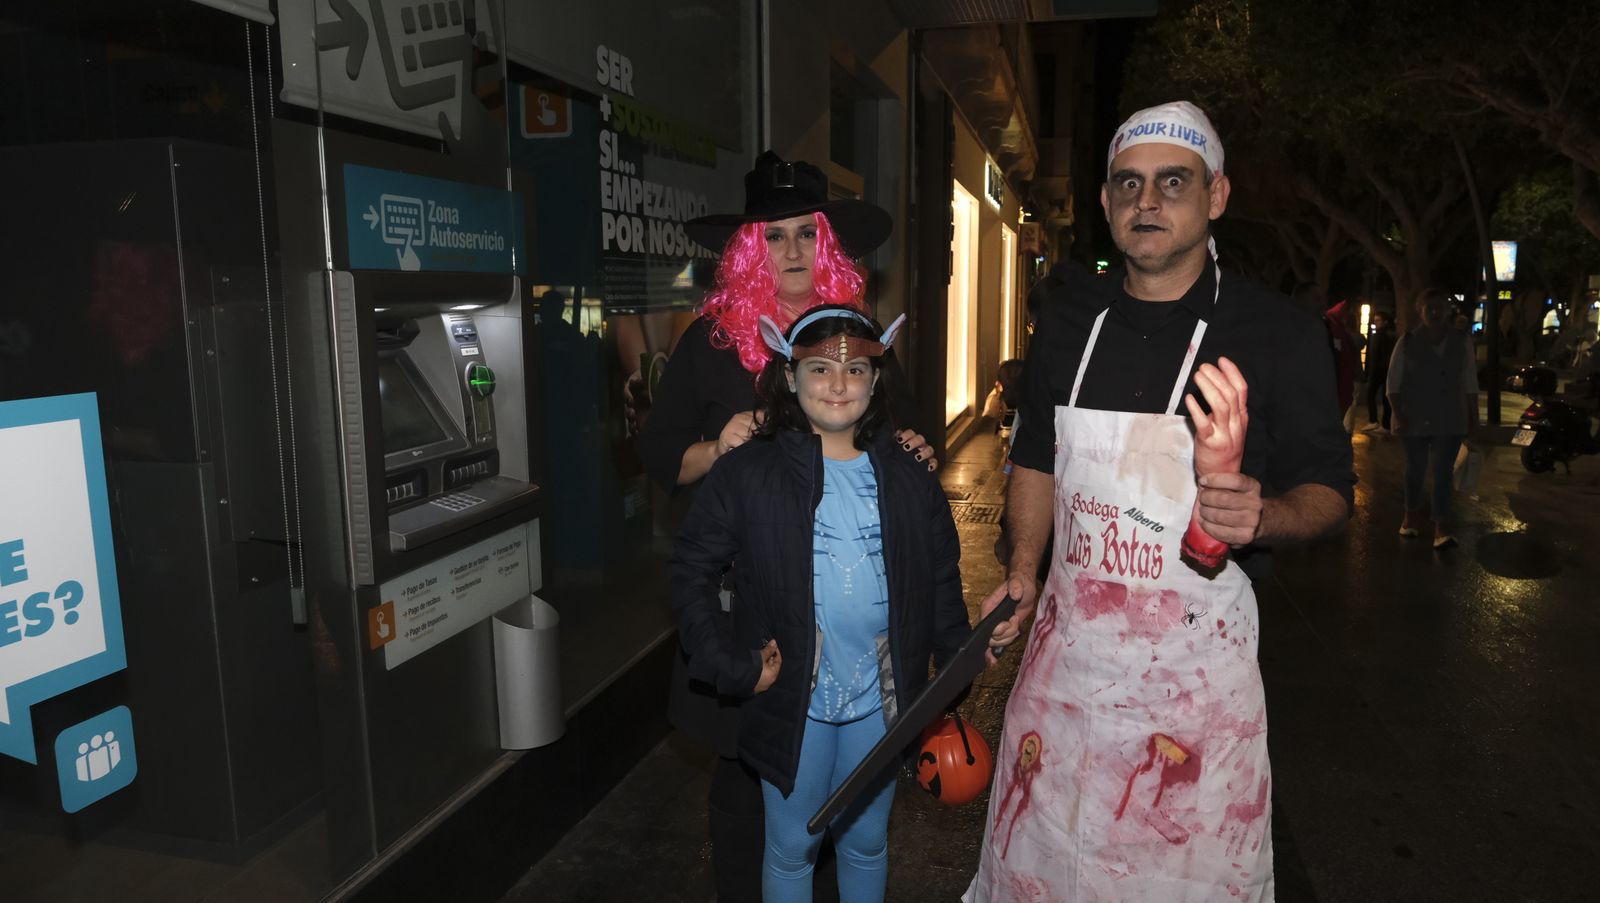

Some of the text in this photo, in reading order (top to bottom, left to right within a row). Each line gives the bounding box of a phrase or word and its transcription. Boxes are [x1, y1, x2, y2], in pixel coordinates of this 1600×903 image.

[596, 44, 634, 97] SER
[1127, 122, 1167, 141] YOUR
[1169, 123, 1207, 153] LIVER
[427, 200, 460, 225] Zona
[429, 225, 505, 251] Autoservicio
[601, 211, 646, 254] POR
[1071, 492, 1120, 522] Bodega
[1123, 507, 1165, 533] Alberto
[1066, 512, 1163, 580] Las Botas
